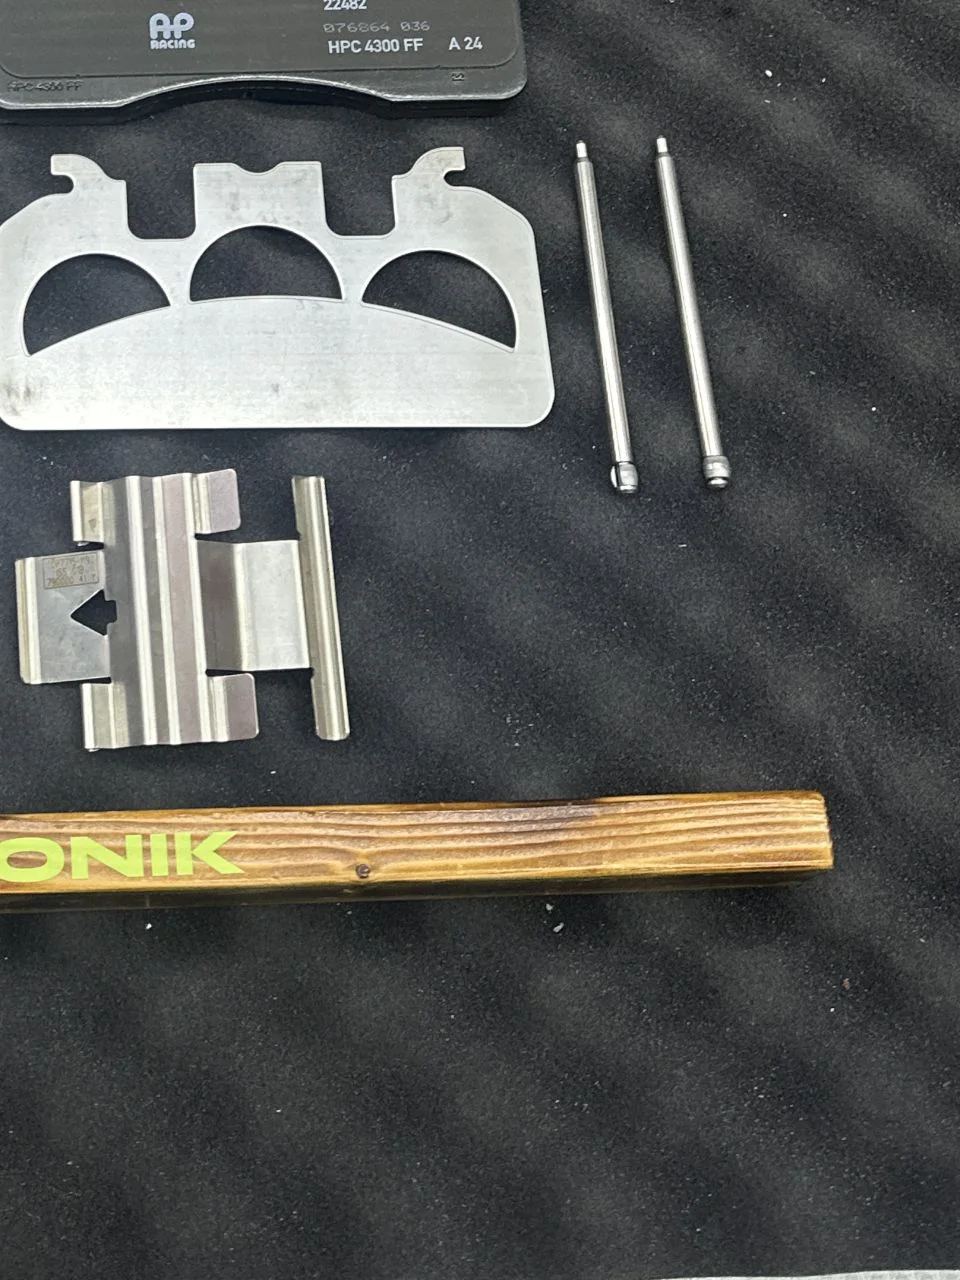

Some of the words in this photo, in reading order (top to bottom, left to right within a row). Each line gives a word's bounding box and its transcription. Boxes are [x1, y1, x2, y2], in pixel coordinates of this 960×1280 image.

[149, 12, 194, 37] AP
[322, 22, 390, 34] 076864
[399, 20, 431, 32] 036
[151, 37, 195, 49] RACING
[327, 39, 362, 54] HPC
[364, 38, 400, 53] 4300
[403, 37, 424, 52] FF
[448, 36, 461, 51] A
[463, 36, 483, 50] 24
